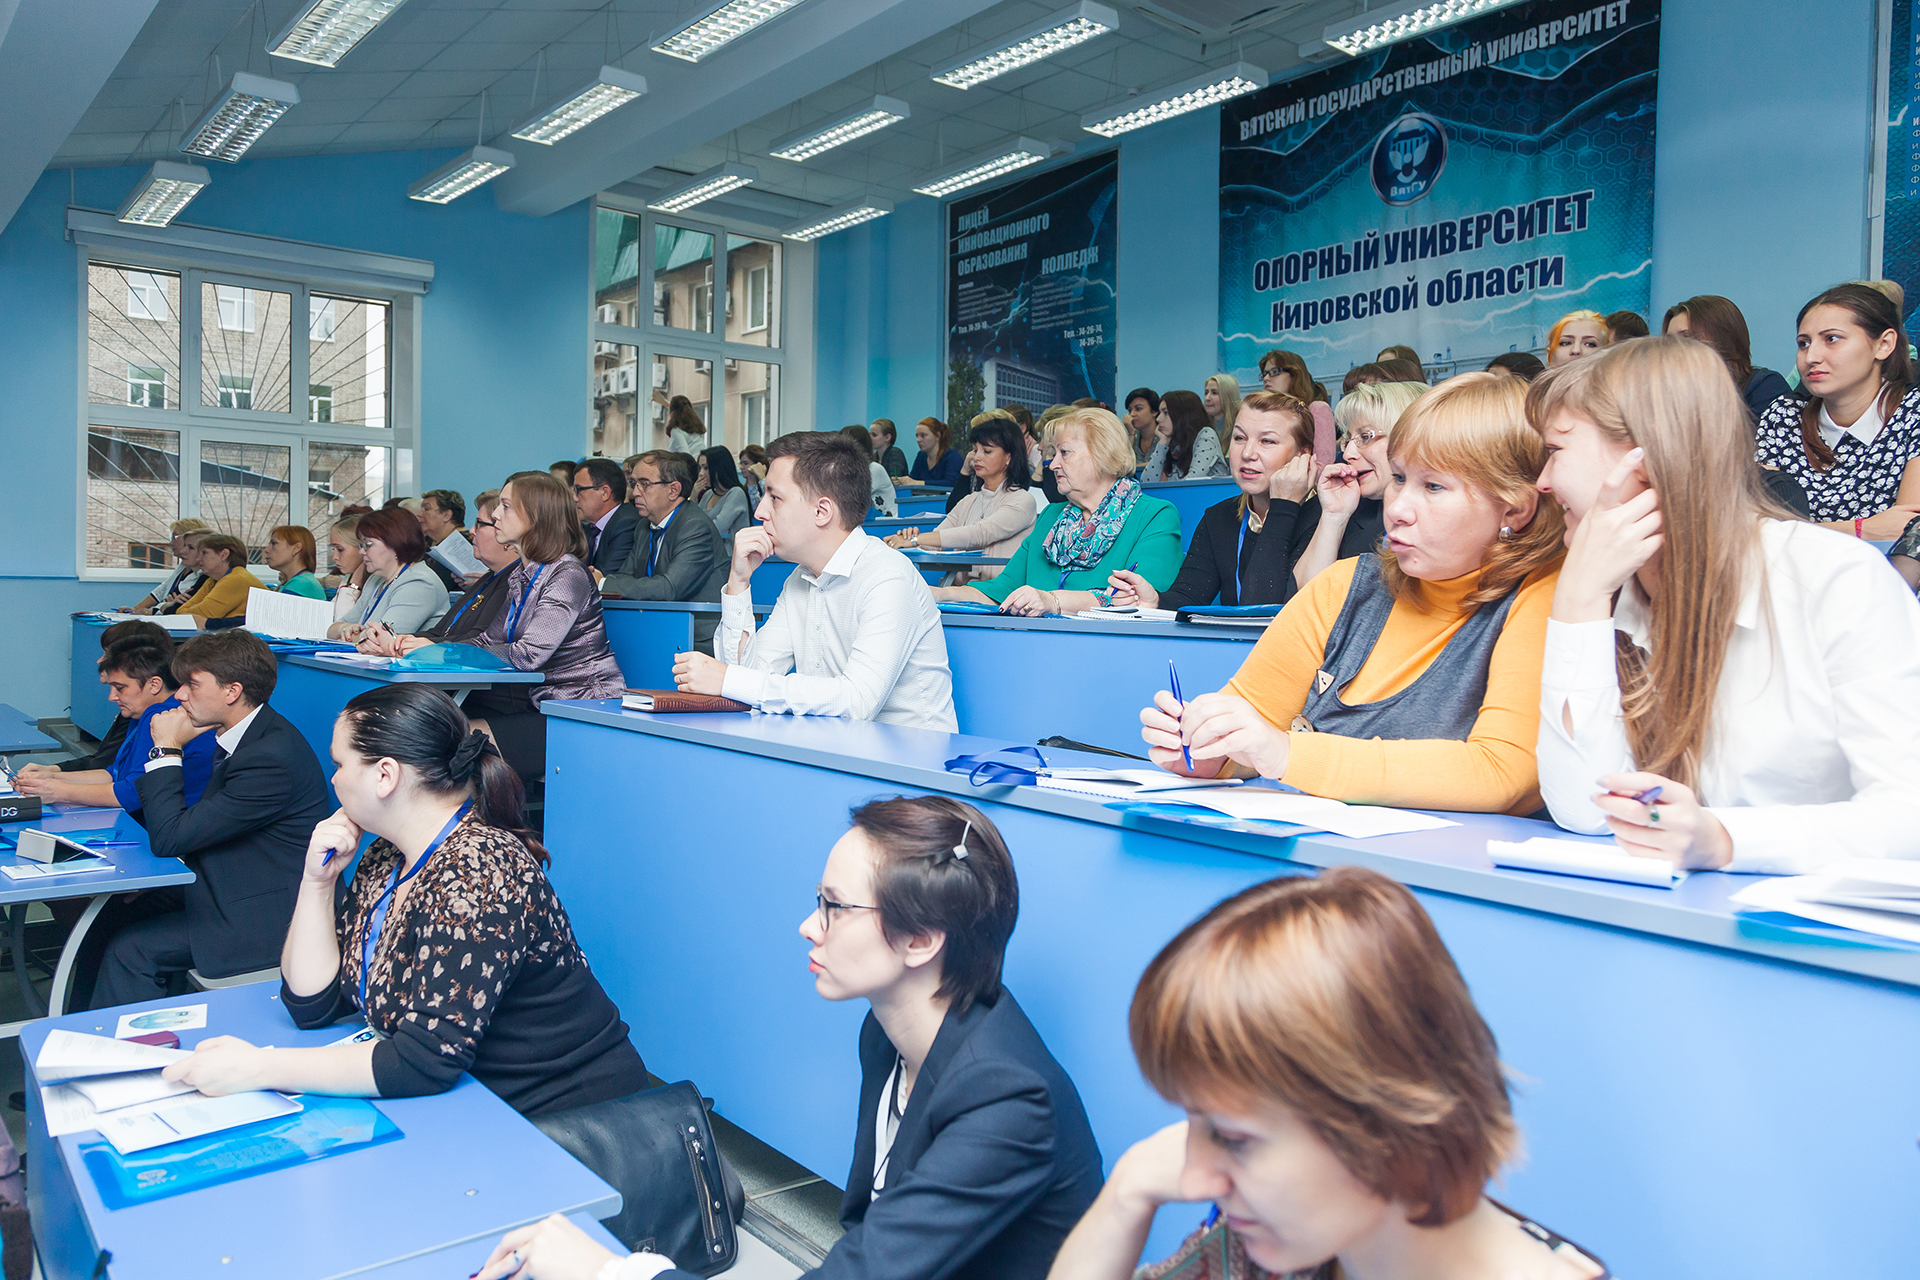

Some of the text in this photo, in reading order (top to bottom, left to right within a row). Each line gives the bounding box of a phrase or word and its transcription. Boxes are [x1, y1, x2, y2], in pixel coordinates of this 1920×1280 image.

[1240, 0, 1630, 141] ВЯТСКИЙ ГОСУДАРСТВЕННЫЙ УНИВЕРСИТЕТ
[1390, 180, 1427, 197] ВятГУ
[958, 205, 989, 233] ЛИЦЕЙ
[958, 212, 1050, 254] ИННОВАЦИОННОГО
[1253, 189, 1595, 292] ОПОРНЫЙ УНИВЕРСИТЕТ
[958, 242, 1028, 276] ОБРАЗОВАНИЯ
[1041, 245, 1099, 275] КОЛЛЕДЖ
[1271, 255, 1565, 334] Кировской области
[1, 807, 18, 817] DG
